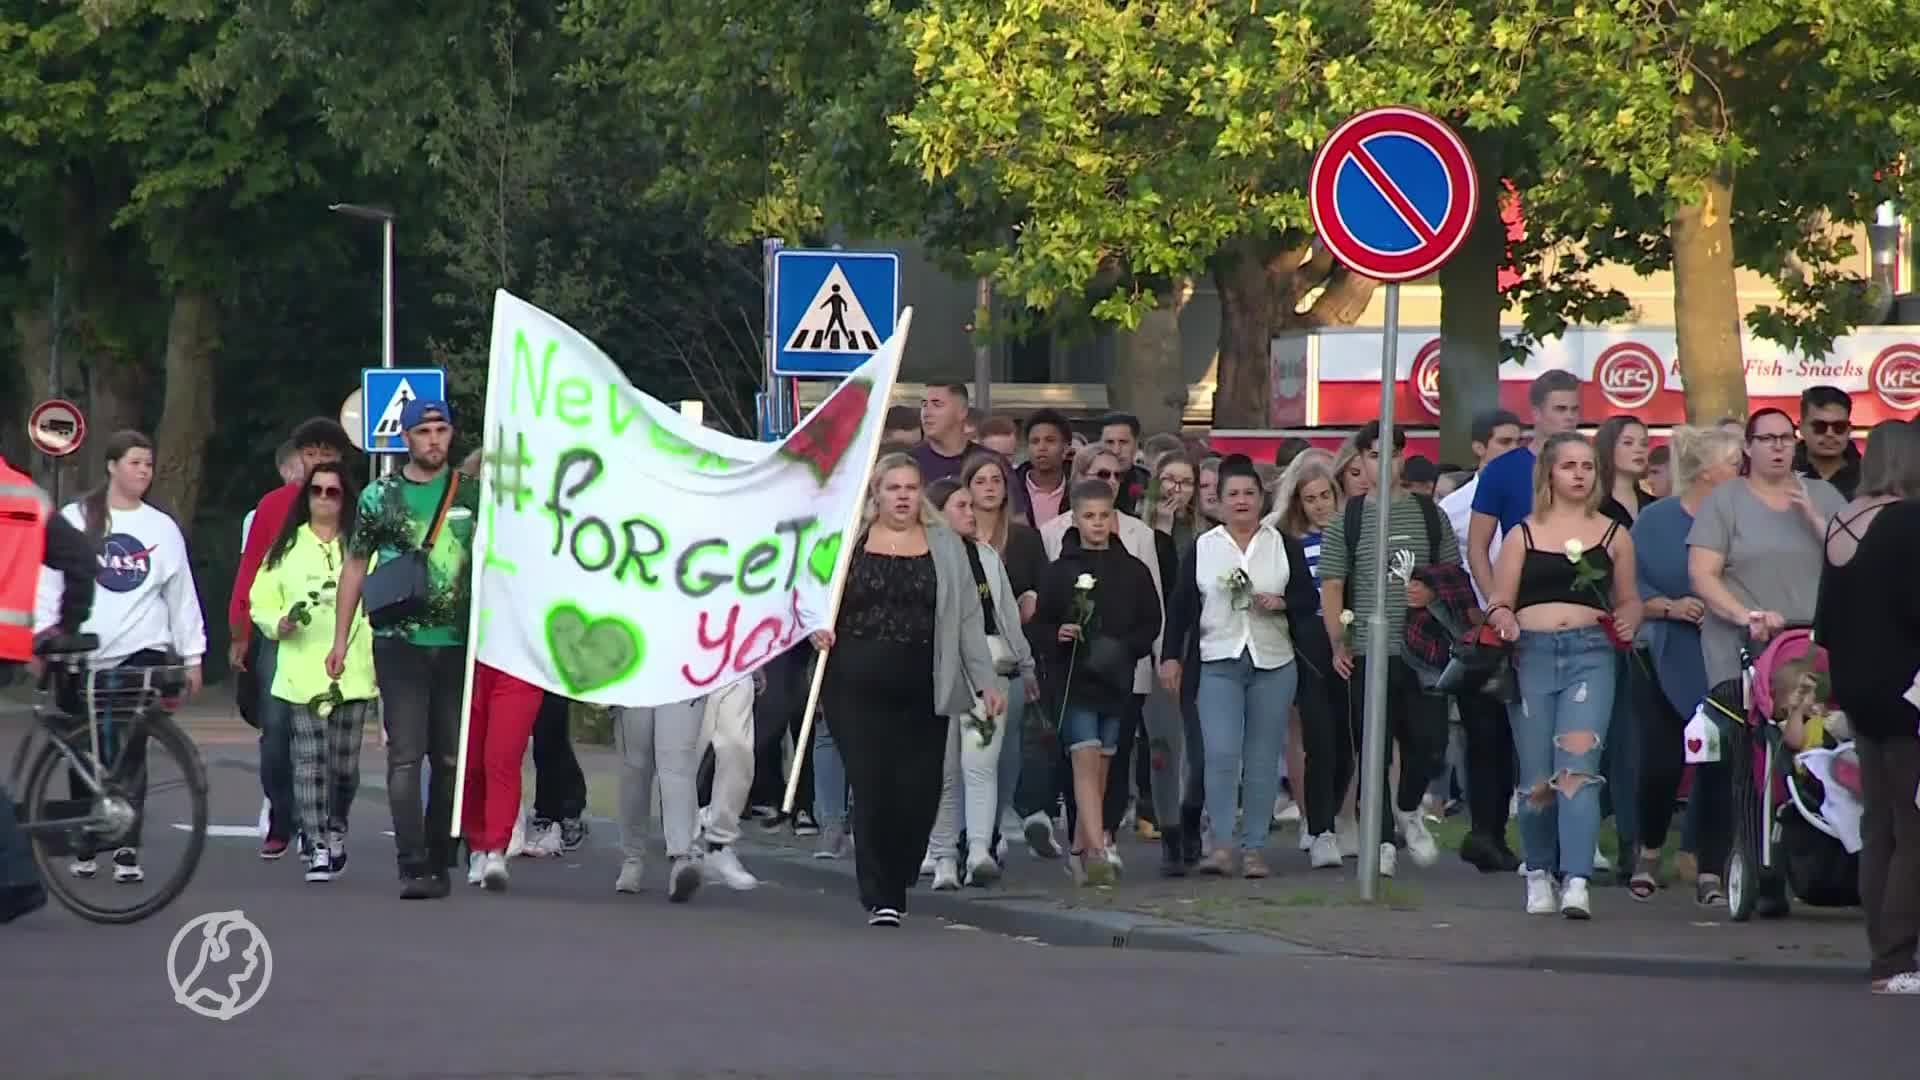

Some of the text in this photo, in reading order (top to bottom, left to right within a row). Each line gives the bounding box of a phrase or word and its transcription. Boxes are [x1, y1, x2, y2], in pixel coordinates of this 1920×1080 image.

[1606, 368, 1652, 392] KFS
[510, 328, 731, 469] Nev
[96, 554, 148, 573] NASA
